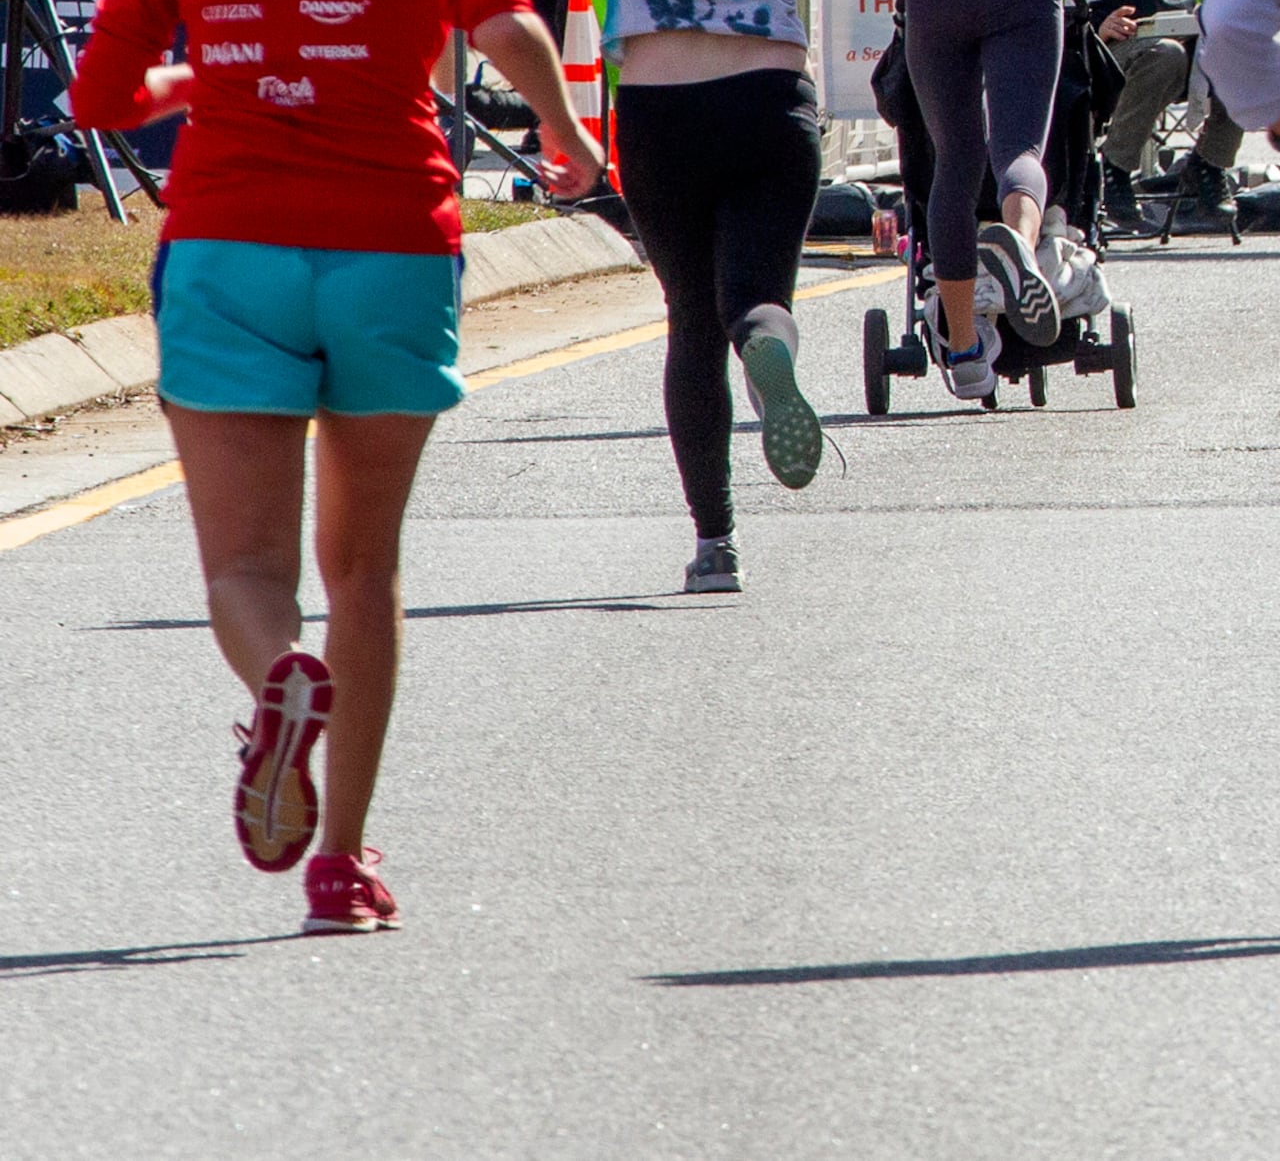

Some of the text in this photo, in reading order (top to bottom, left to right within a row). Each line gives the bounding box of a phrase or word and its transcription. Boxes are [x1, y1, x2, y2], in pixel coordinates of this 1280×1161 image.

[201, 3, 263, 22] CITIZEN
[299, 0, 366, 15] DANNON
[201, 42, 264, 66] DASANI
